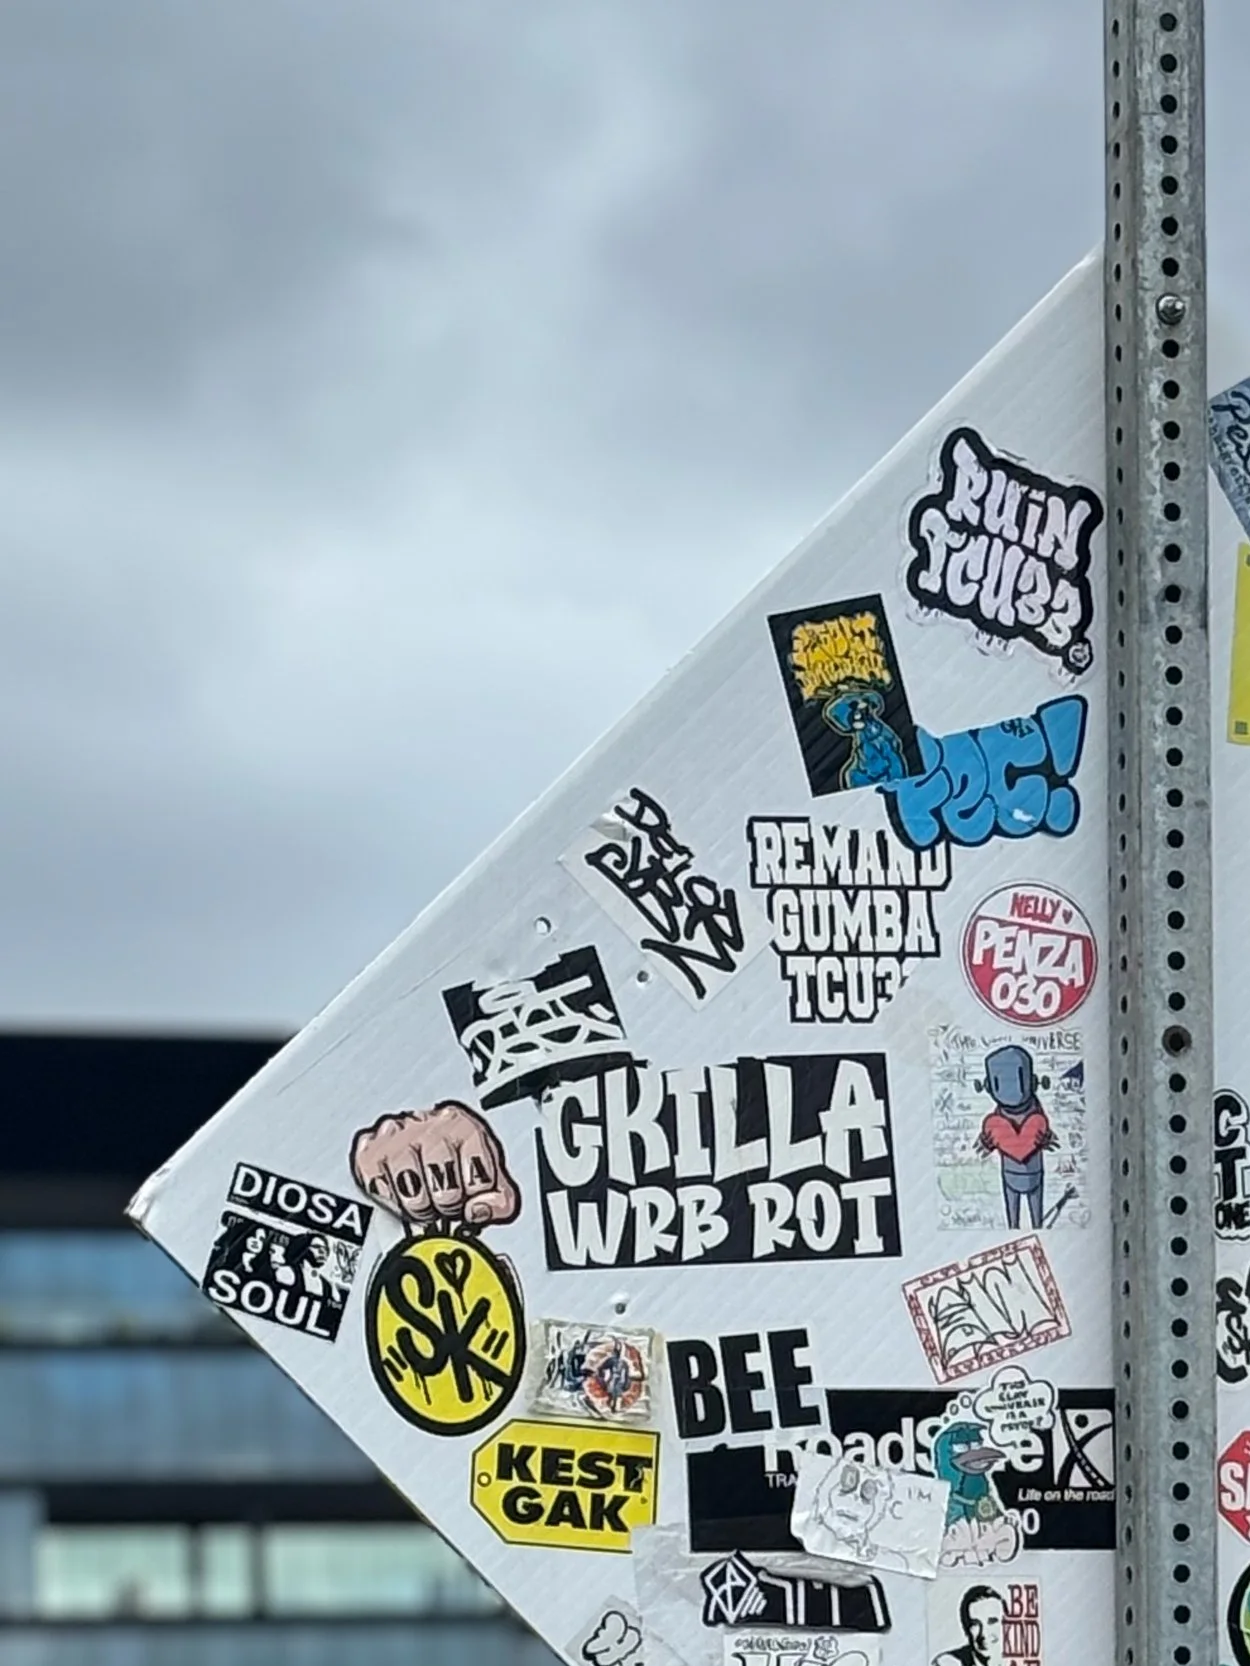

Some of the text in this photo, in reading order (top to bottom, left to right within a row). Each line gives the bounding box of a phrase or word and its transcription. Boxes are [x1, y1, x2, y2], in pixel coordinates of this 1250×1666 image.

[774, 890, 936, 952] GUMBA
[1012, 893, 1059, 921] NELLY
[973, 921, 1086, 986] PENZA
[233, 1166, 362, 1236] DIOSA
[369, 1156, 491, 1199] COMA
[547, 1177, 891, 1265] WRB ROT
[209, 1270, 330, 1337] SOUL
[667, 1329, 821, 1439] BEE
[496, 1443, 653, 1493] KEST
[502, 1486, 629, 1532] GAK
[1018, 1488, 1115, 1500] Life on the road
[1007, 1584, 1039, 1618] BE
[1002, 1619, 1041, 1658] KIND
